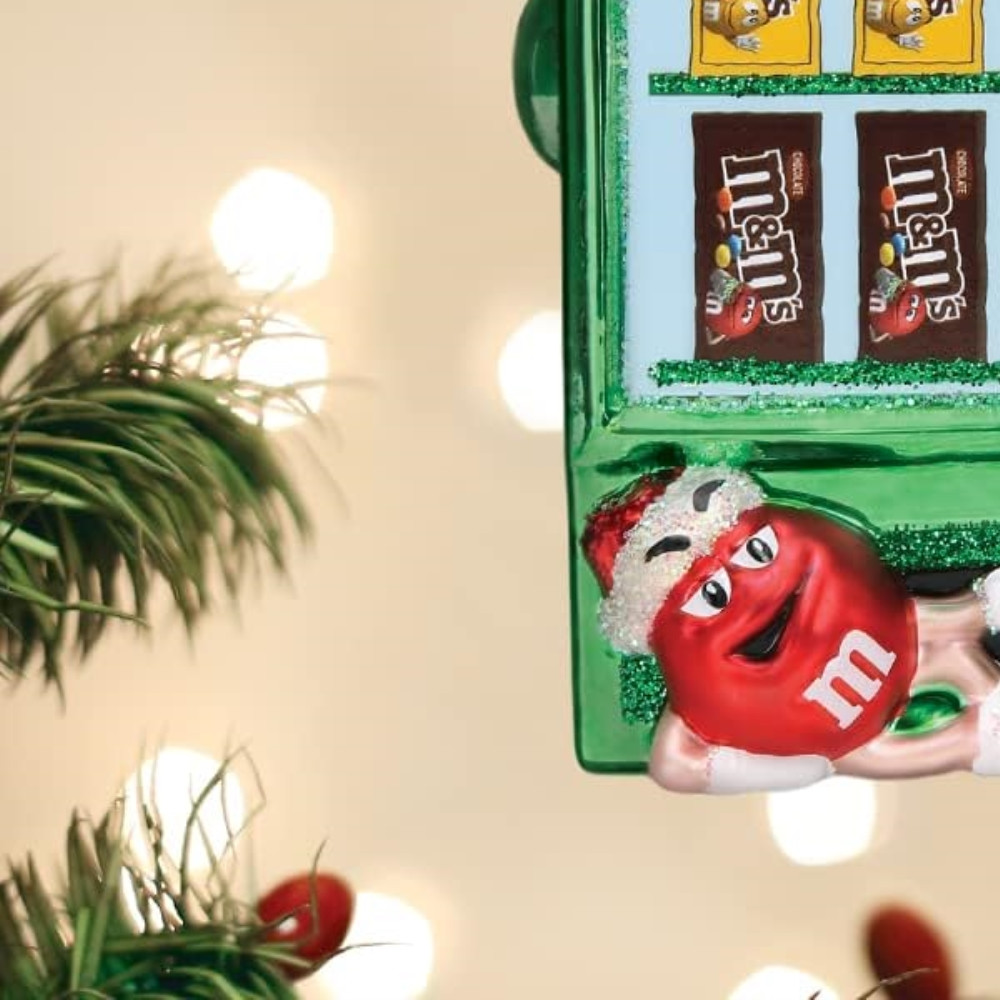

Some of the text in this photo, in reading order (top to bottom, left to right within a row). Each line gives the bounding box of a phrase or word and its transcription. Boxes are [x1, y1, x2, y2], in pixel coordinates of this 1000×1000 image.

[792, 150, 804, 196] CHOCOLATE
[956, 149, 967, 195] CHOCOLATE
[803, 629, 897, 730] m
